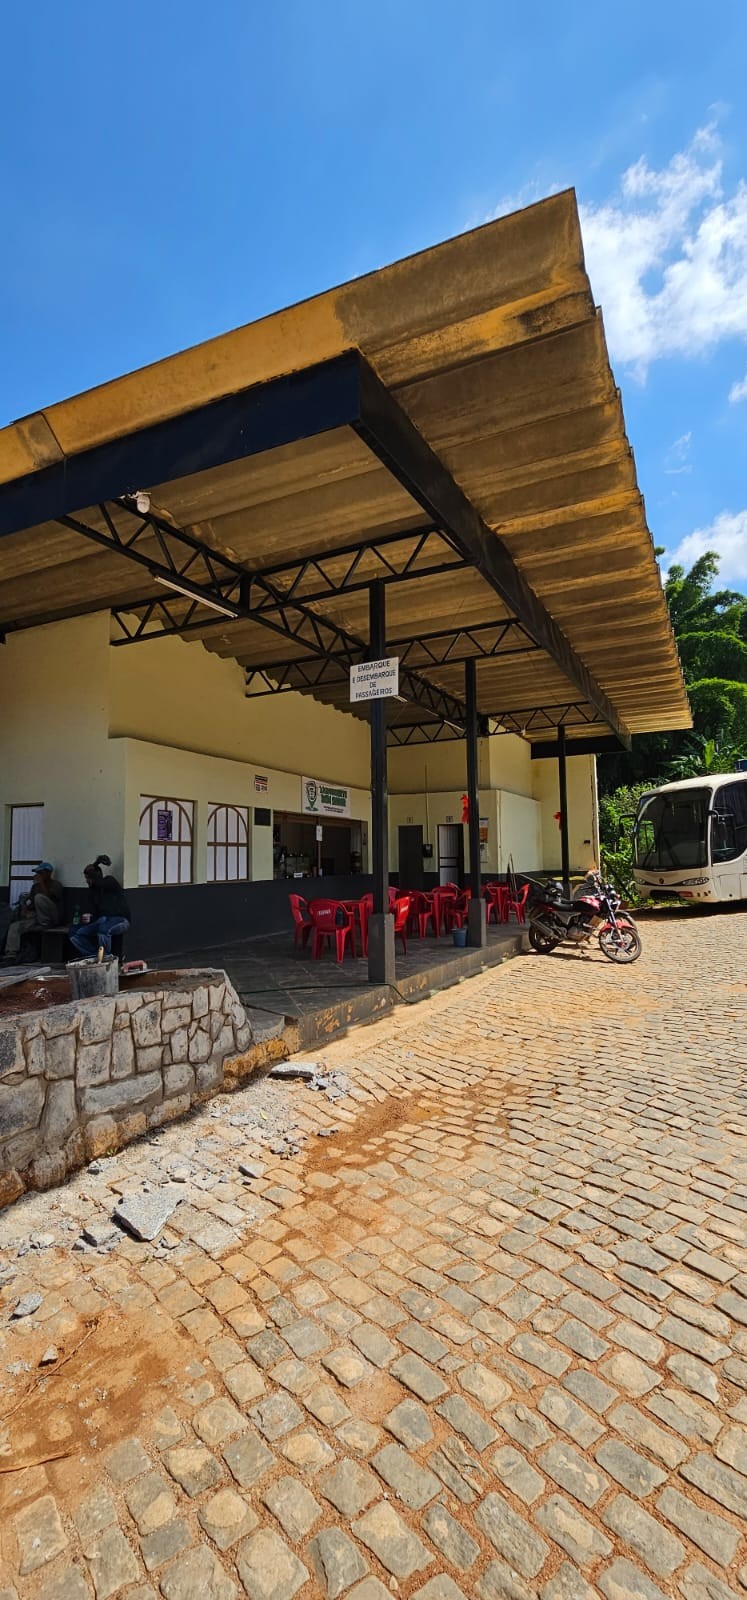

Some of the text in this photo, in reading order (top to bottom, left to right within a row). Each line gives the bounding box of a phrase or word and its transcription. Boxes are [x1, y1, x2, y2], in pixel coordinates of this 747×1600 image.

[358, 660, 390, 672] EMBARQUE
[356, 670, 396, 682] DESEMBARQUE
[356, 688, 392, 699] PASSAGEIROS
